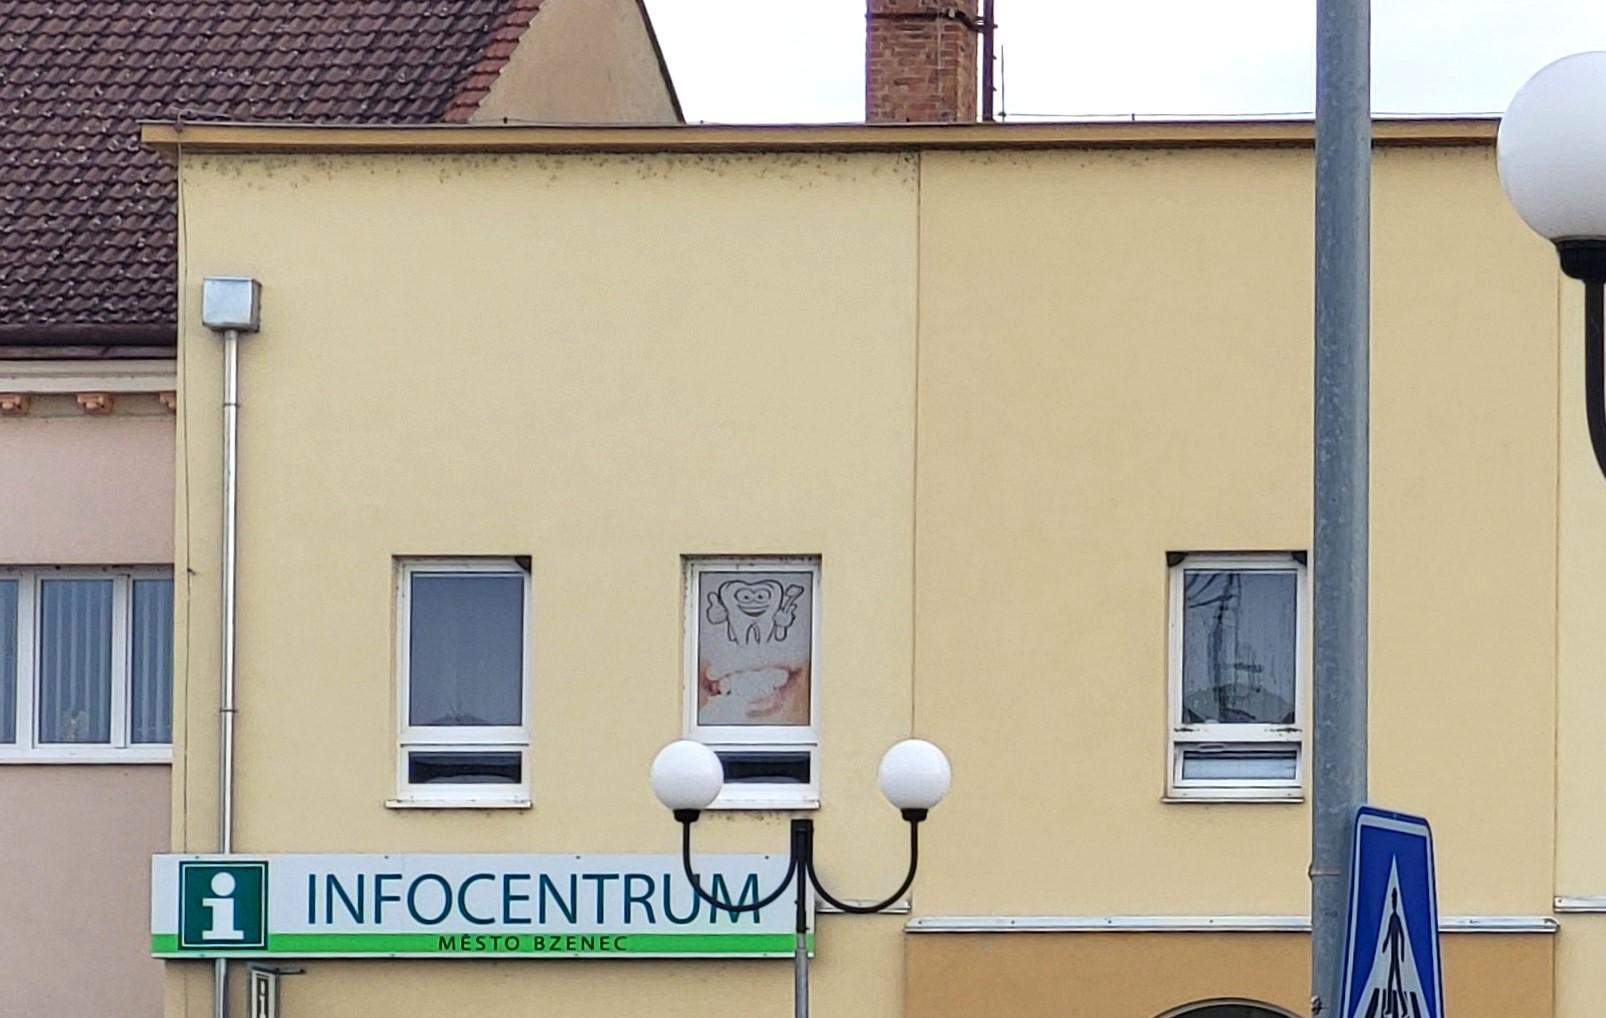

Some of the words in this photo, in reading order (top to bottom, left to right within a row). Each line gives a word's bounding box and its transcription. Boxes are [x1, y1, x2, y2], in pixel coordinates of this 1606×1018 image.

[307, 873, 762, 926] INFOCENTRUM
[438, 934, 521, 952] MĚSTO
[533, 935, 629, 952] BZENEC
